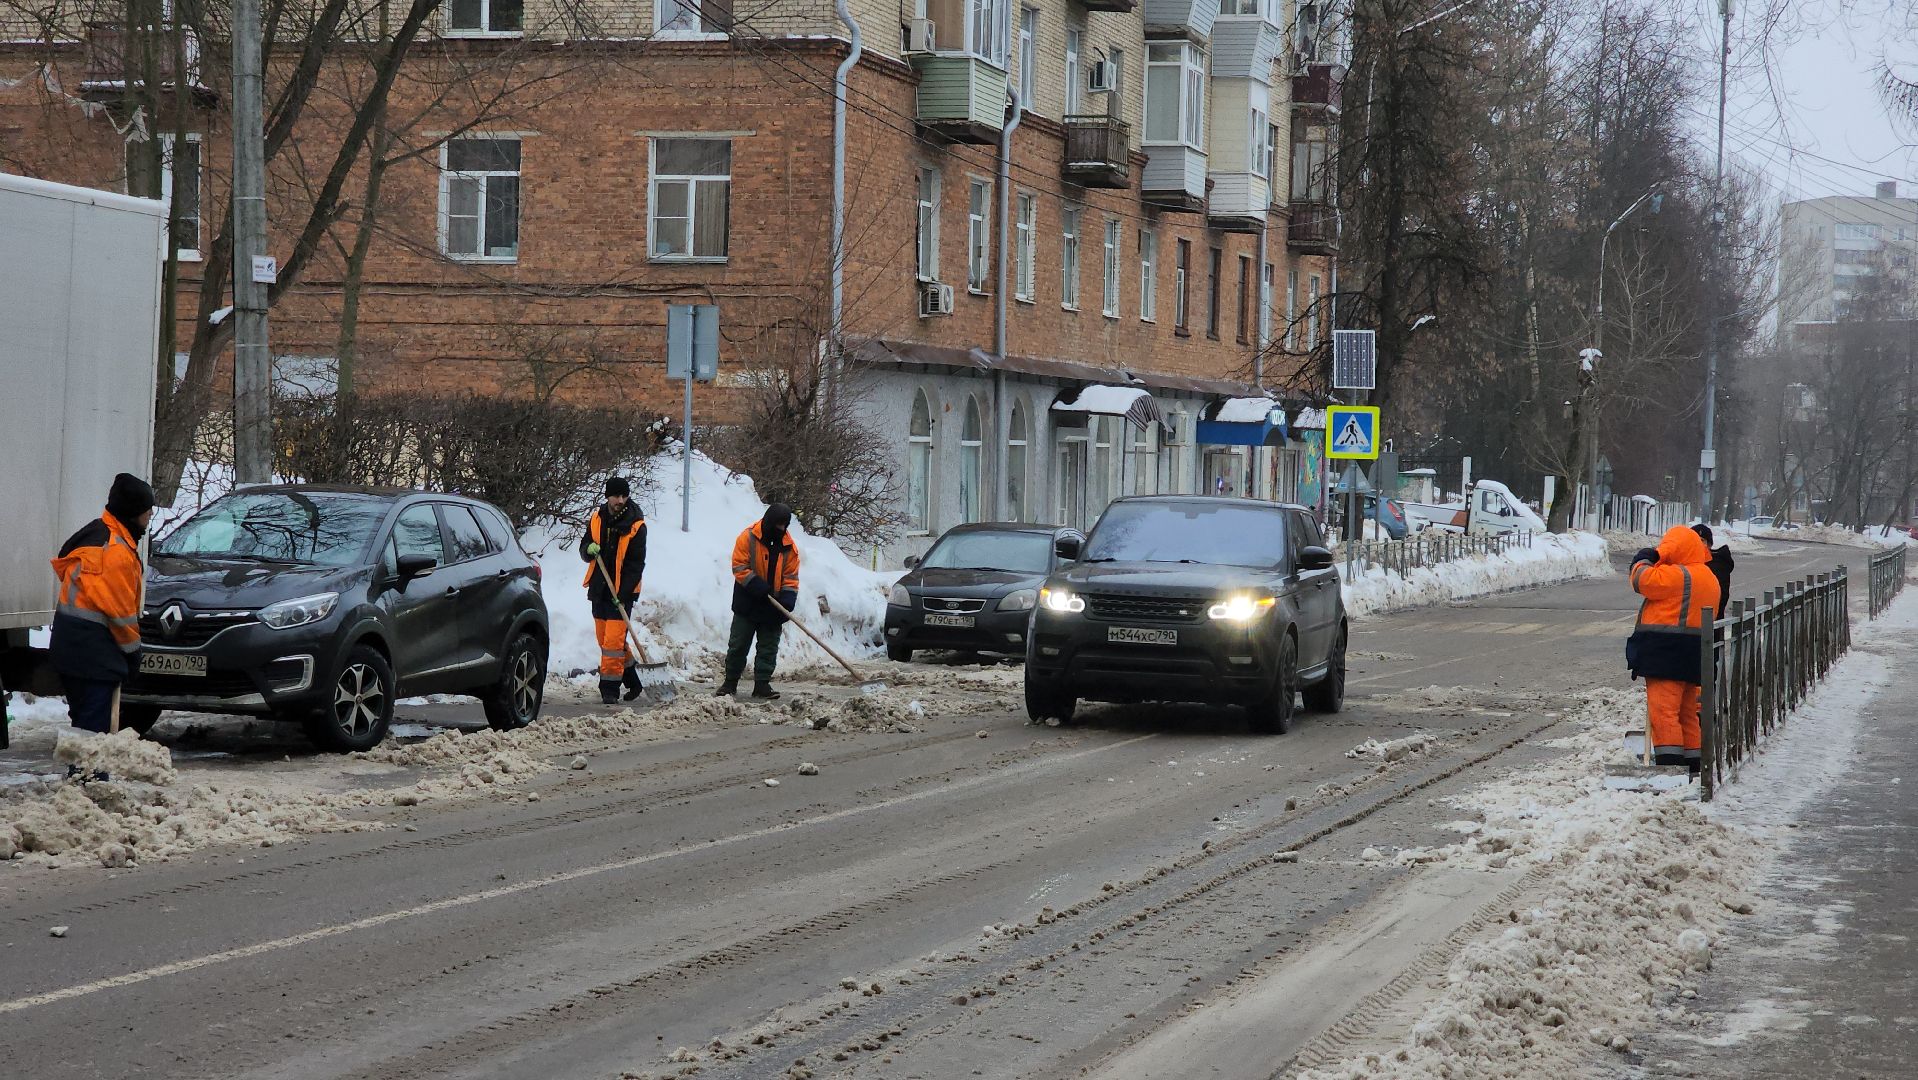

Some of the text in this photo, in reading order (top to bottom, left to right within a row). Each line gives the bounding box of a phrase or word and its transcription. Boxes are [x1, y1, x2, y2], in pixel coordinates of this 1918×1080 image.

[1109, 628, 1175, 642] М544ХС 790
[184, 655, 204, 668] 790
